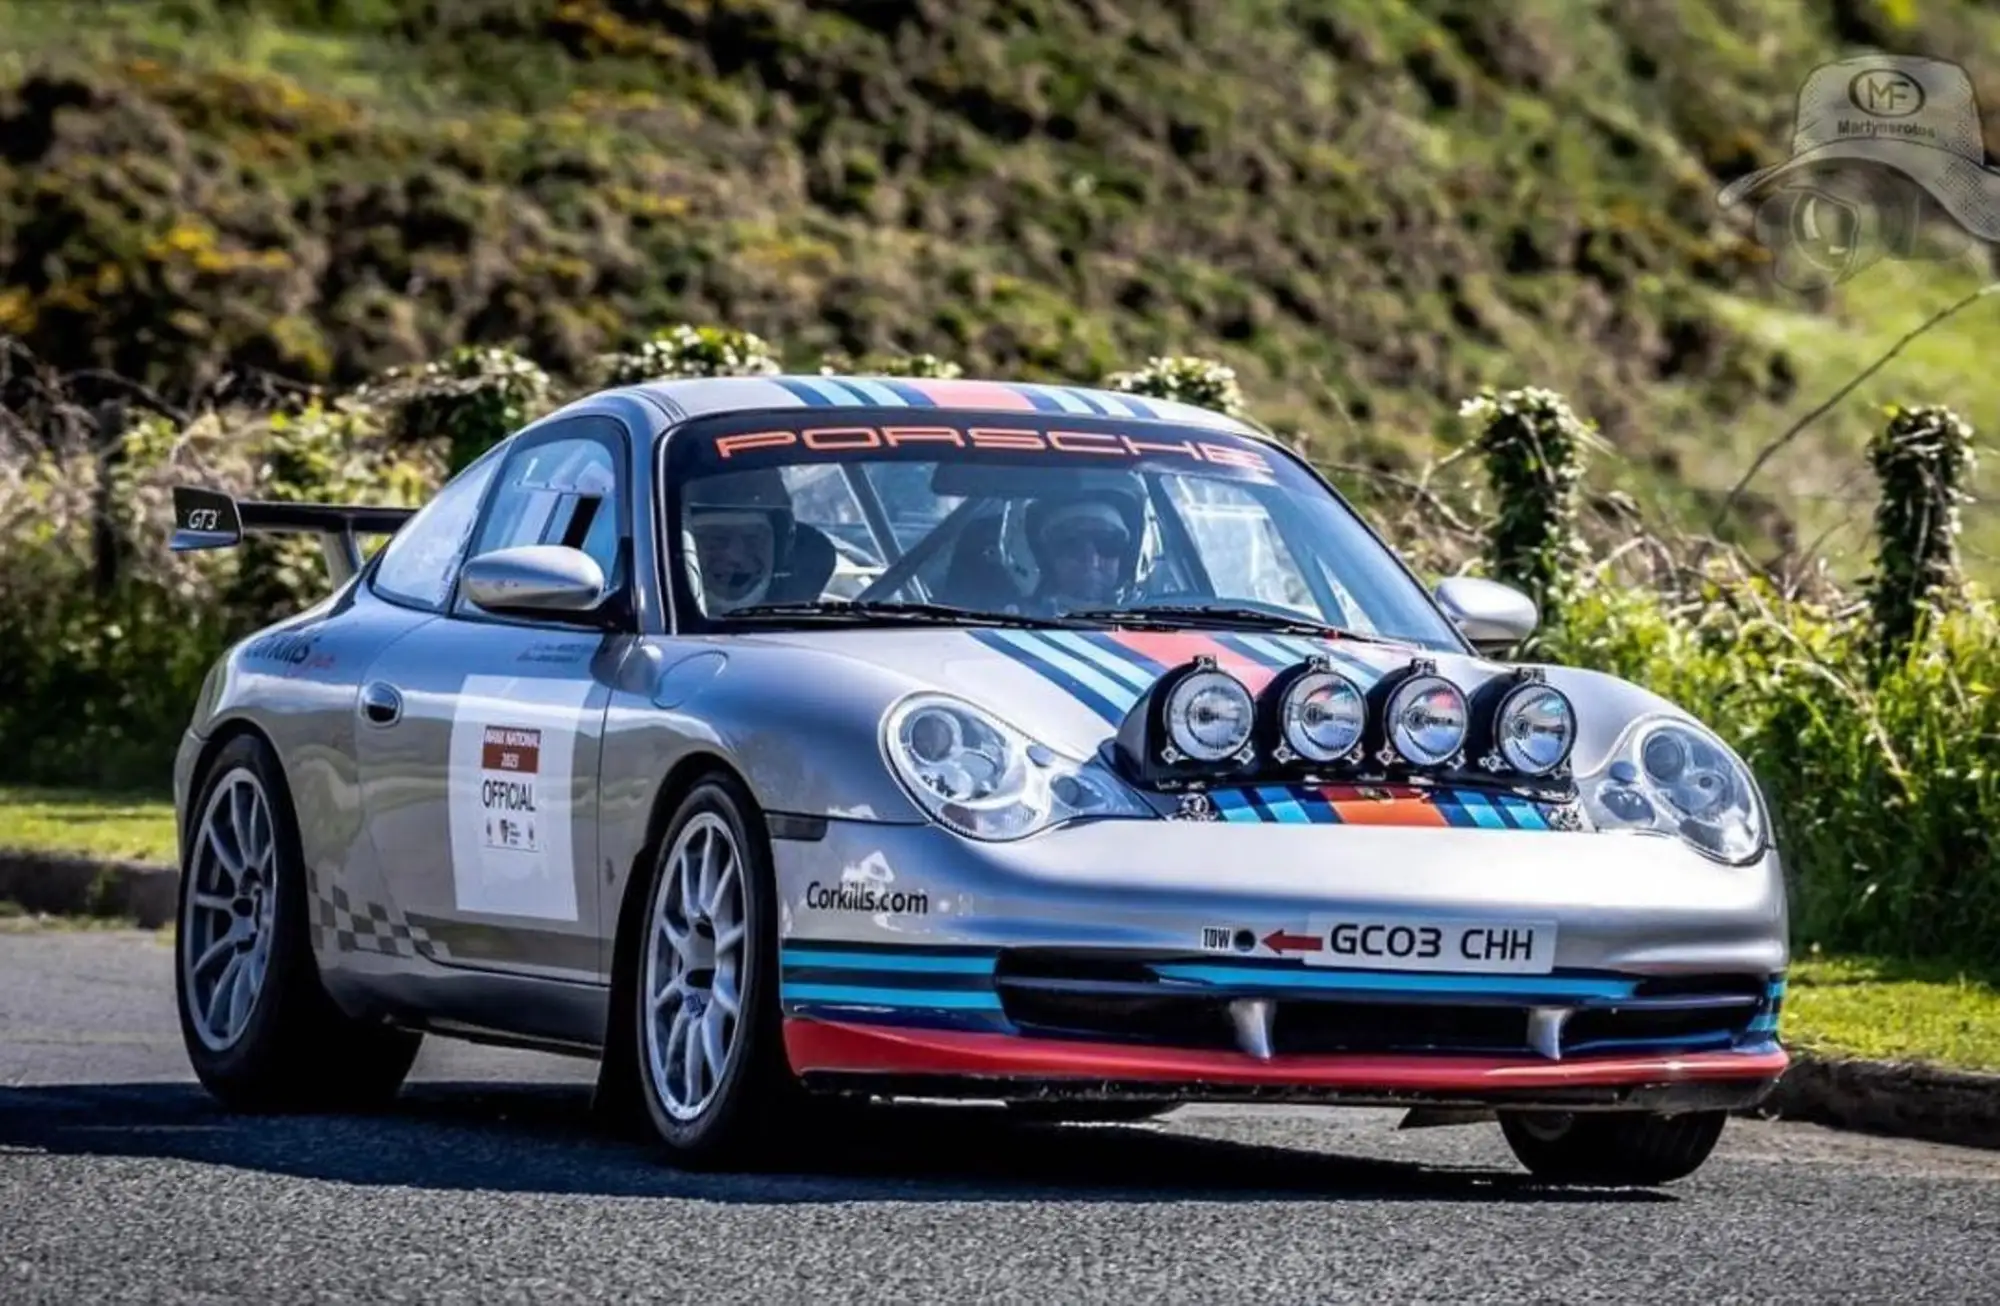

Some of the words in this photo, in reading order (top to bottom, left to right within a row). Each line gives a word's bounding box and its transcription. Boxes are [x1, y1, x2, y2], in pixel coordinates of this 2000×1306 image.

[715, 425, 1274, 475] PORSCHE
[188, 508, 218, 530] GT3
[482, 779, 536, 812] OFFICIAL
[806, 880, 929, 915] Corkills.com
[1203, 928, 1231, 949] TOW
[1460, 928, 1534, 960] CHH
